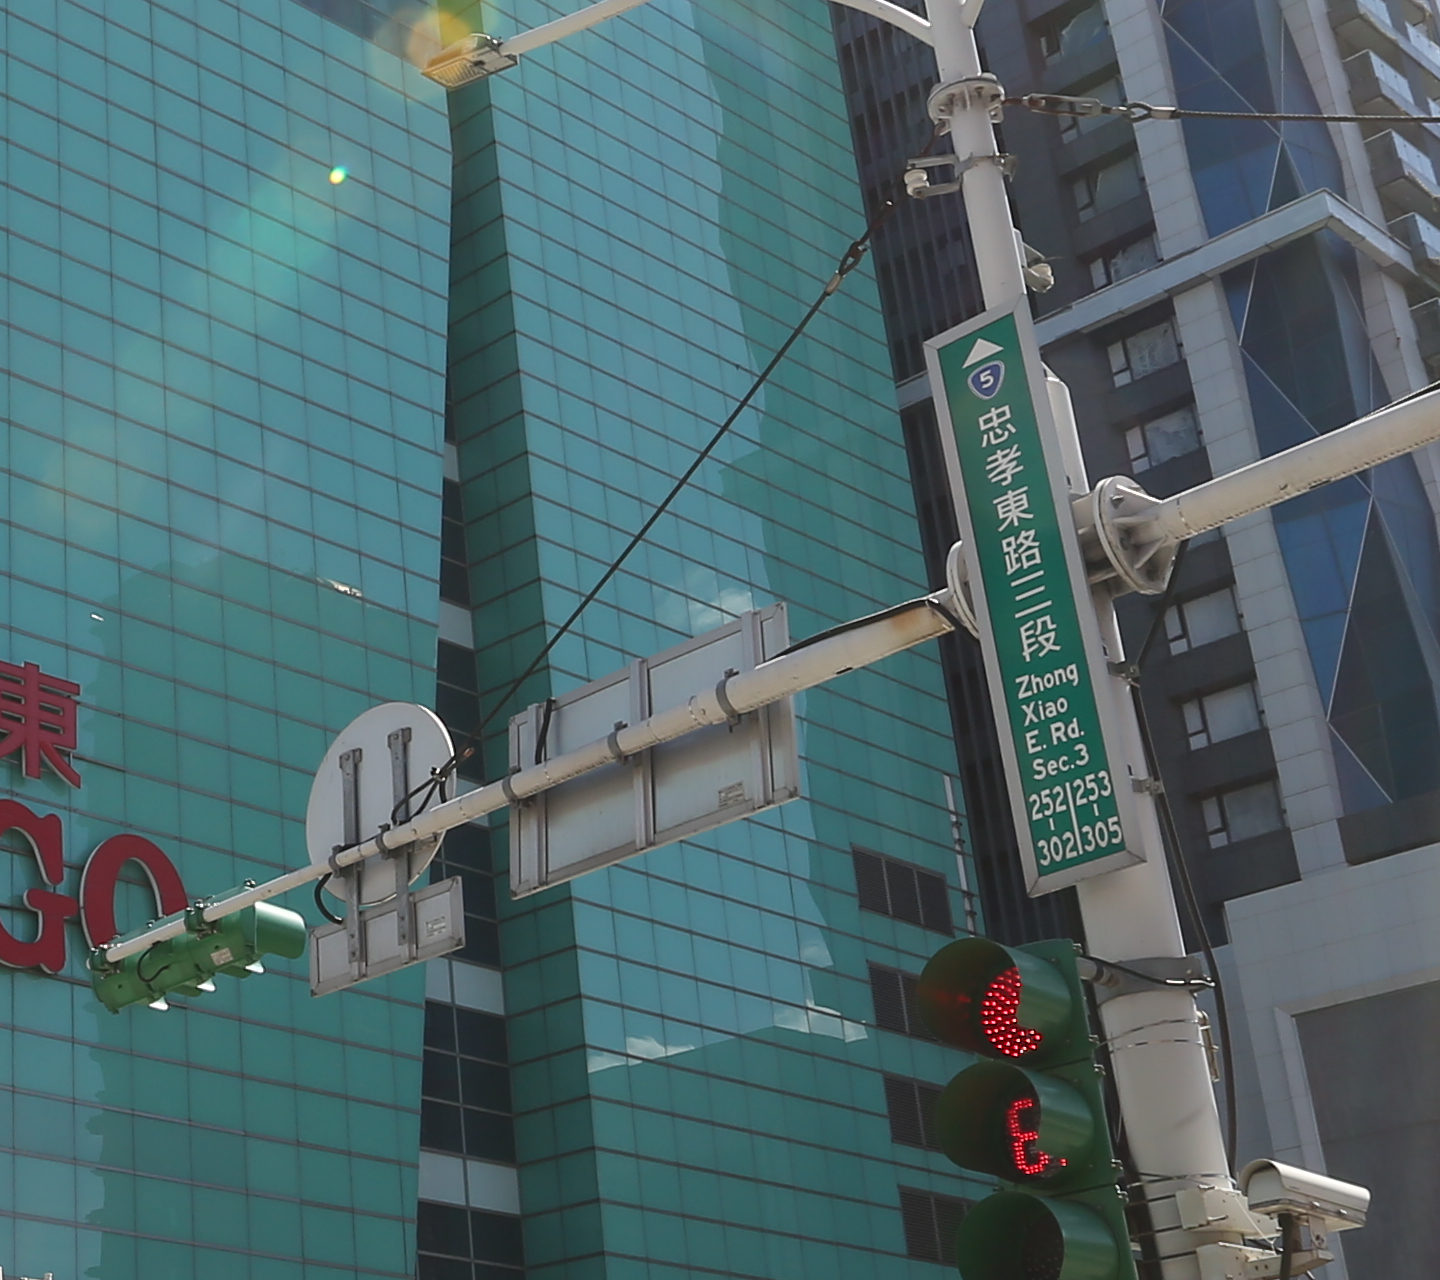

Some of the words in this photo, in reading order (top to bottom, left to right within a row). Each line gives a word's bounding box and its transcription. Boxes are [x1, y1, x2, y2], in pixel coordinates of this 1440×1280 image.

[977, 369, 996, 390] 5
[976, 405, 1062, 664] 忠孝東路三段
[1014, 661, 1080, 701] Zhong
[1021, 696, 1069, 729] Xiao
[1025, 729, 1045, 754] E.
[1050, 719, 1085, 747] Rd.
[1031, 743, 1091, 782] Sec.3
[1030, 791, 1067, 822] 252
[1073, 770, 1113, 807] 253
[1036, 831, 1076, 867] 302
[1082, 814, 1123, 851] 305
